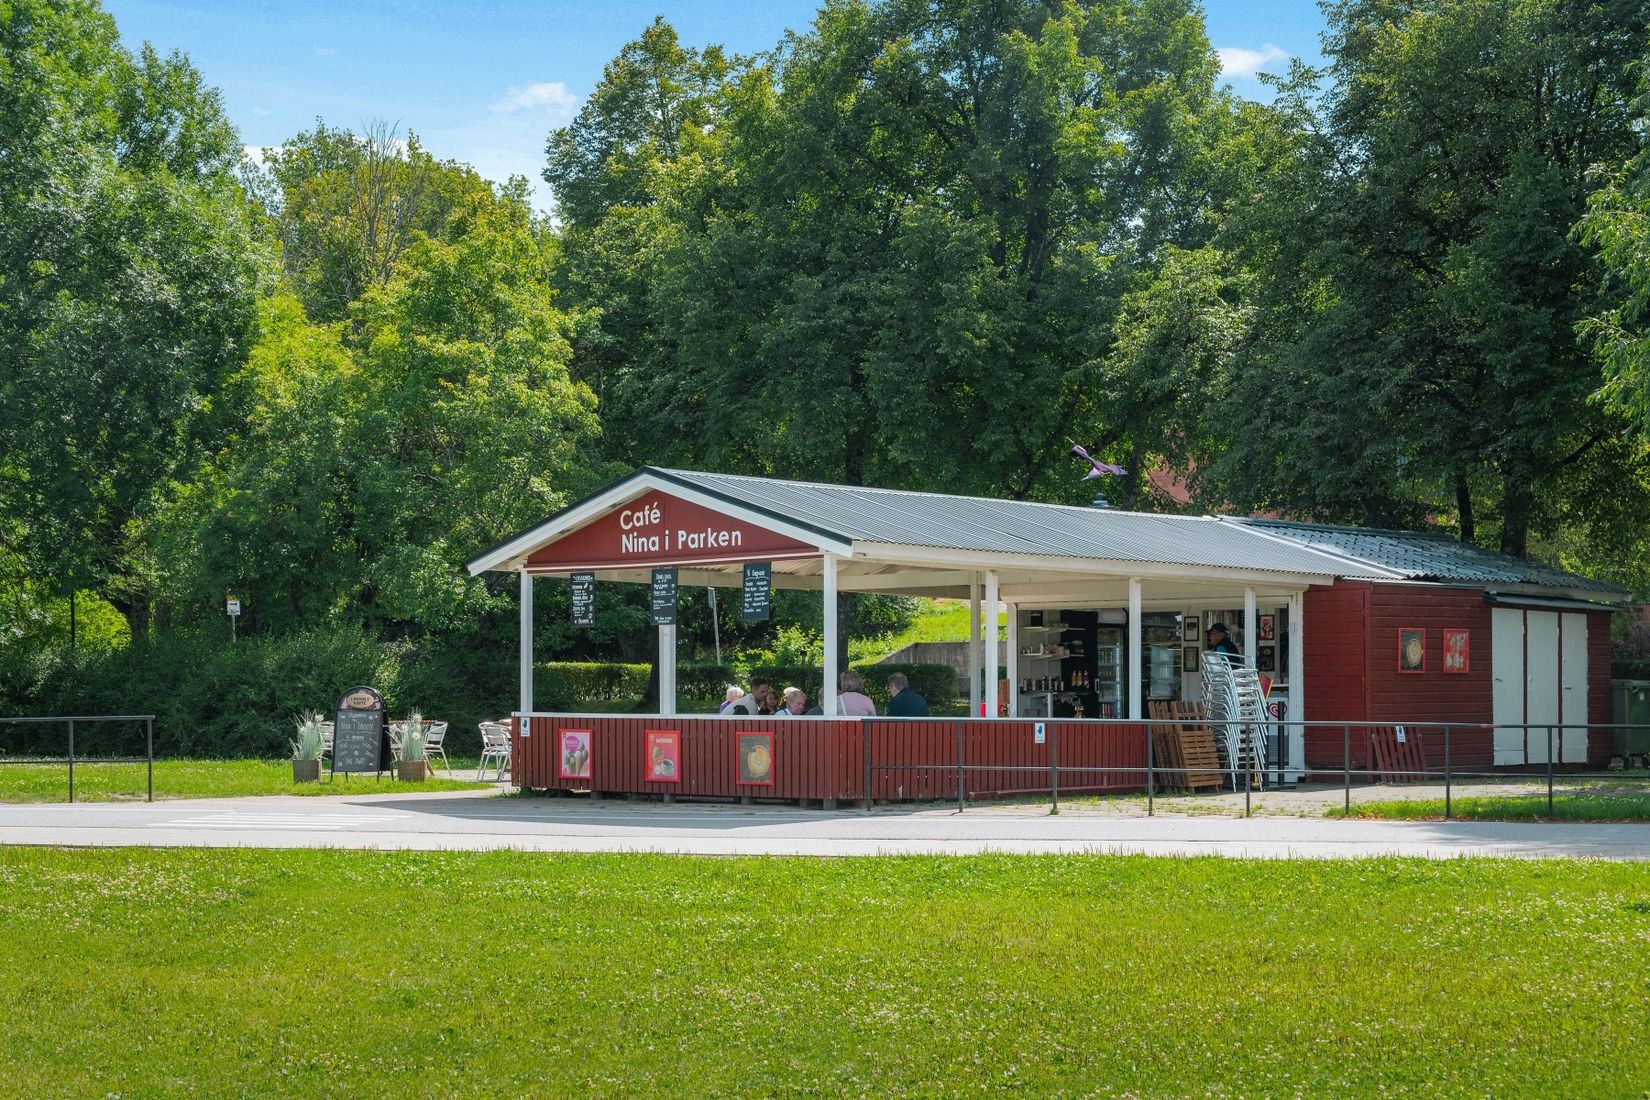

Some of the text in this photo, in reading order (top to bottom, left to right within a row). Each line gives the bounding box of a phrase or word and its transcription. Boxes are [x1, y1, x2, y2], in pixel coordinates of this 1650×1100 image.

[620, 502, 661, 531] Café
[621, 527, 742, 554] Nina i Parken
